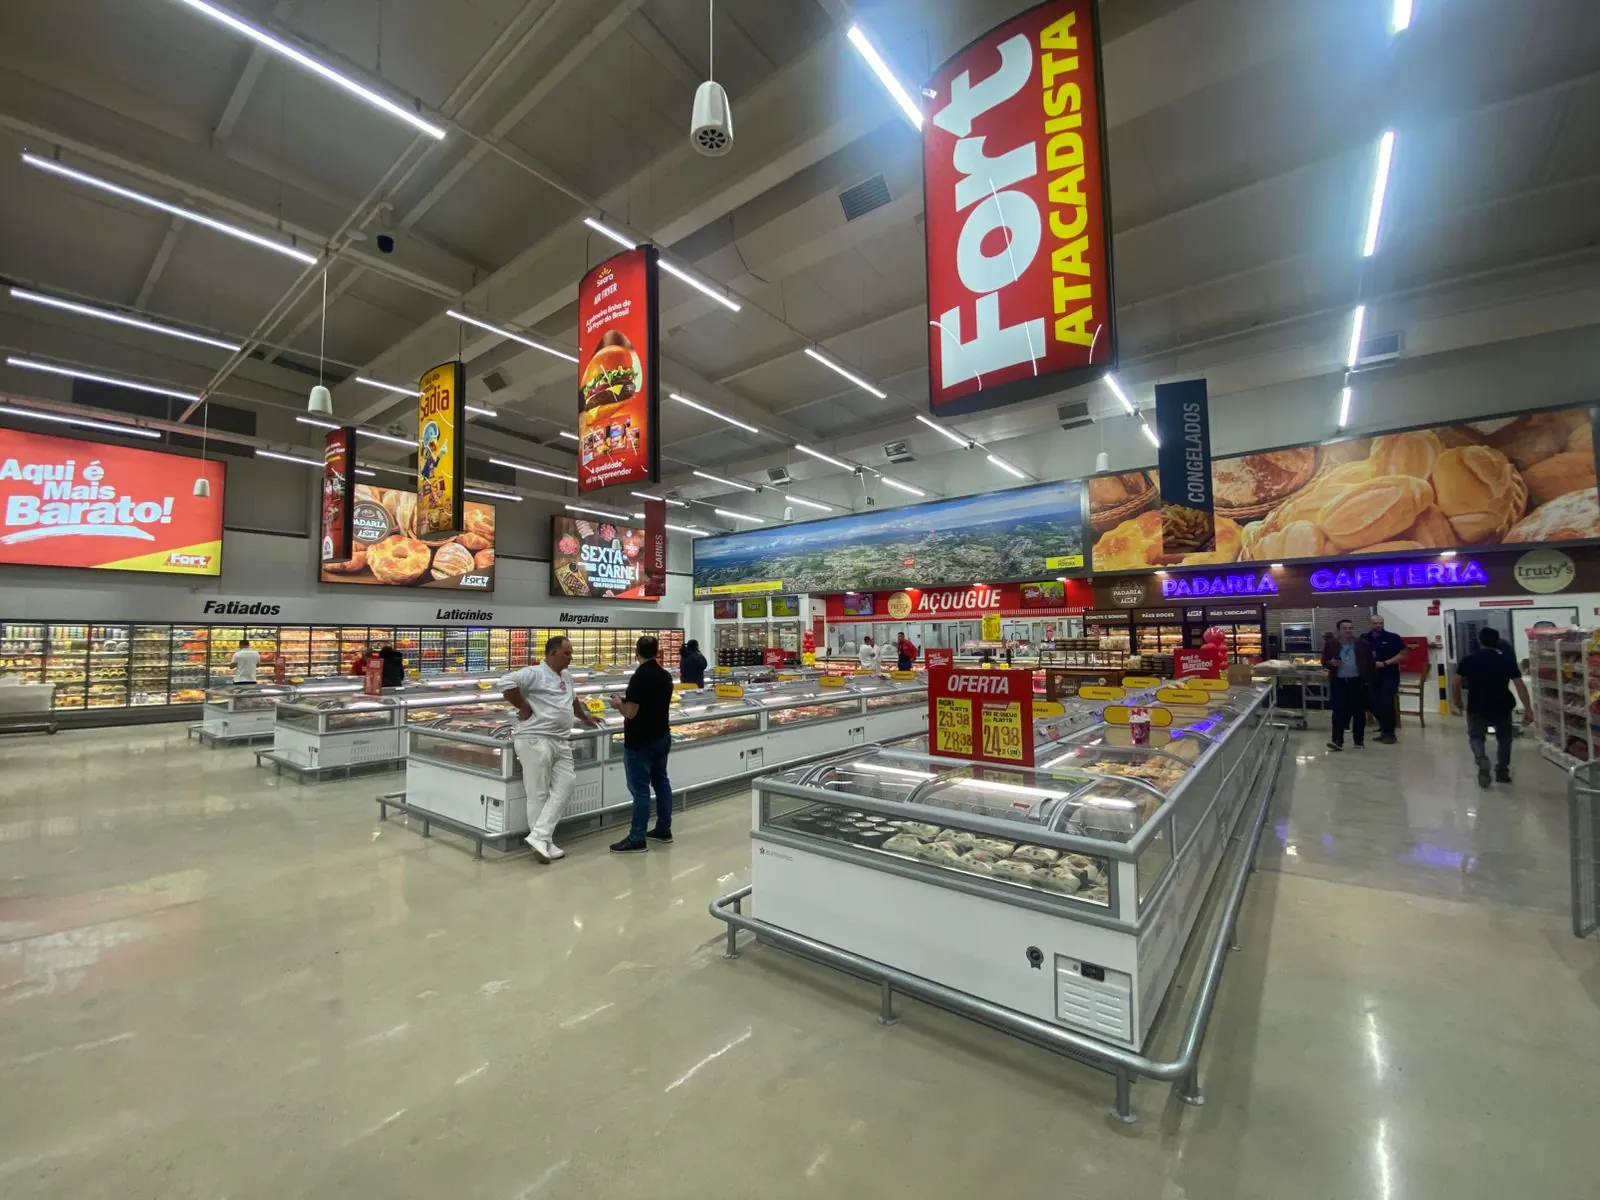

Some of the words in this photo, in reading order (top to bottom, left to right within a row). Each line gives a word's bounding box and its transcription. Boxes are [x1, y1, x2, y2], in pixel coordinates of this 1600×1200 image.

[1040, 11, 1094, 348] ATACADISTA
[932, 32, 1047, 389] Fort
[596, 273, 614, 288] Seara
[1182, 402, 1206, 503] CONGELADOS
[0, 458, 77, 485] Aqui
[83, 460, 104, 481] é
[43, 481, 116, 500] Mais
[5, 495, 175, 526] Barato!
[354, 519, 387, 528] ADARIA
[170, 552, 207, 566] Fort
[655, 534, 664, 569] CARNES
[464, 576, 486, 584] Fort
[1310, 560, 1488, 590] CAFETERIA
[1518, 561, 1573, 578] trudy's
[1162, 573, 1279, 597] PADARIA
[203, 600, 281, 616] Fatiados
[918, 589, 1001, 615] AÇOUGUE
[559, 612, 609, 624] Margarinas
[947, 674, 1009, 694] OFERTA
